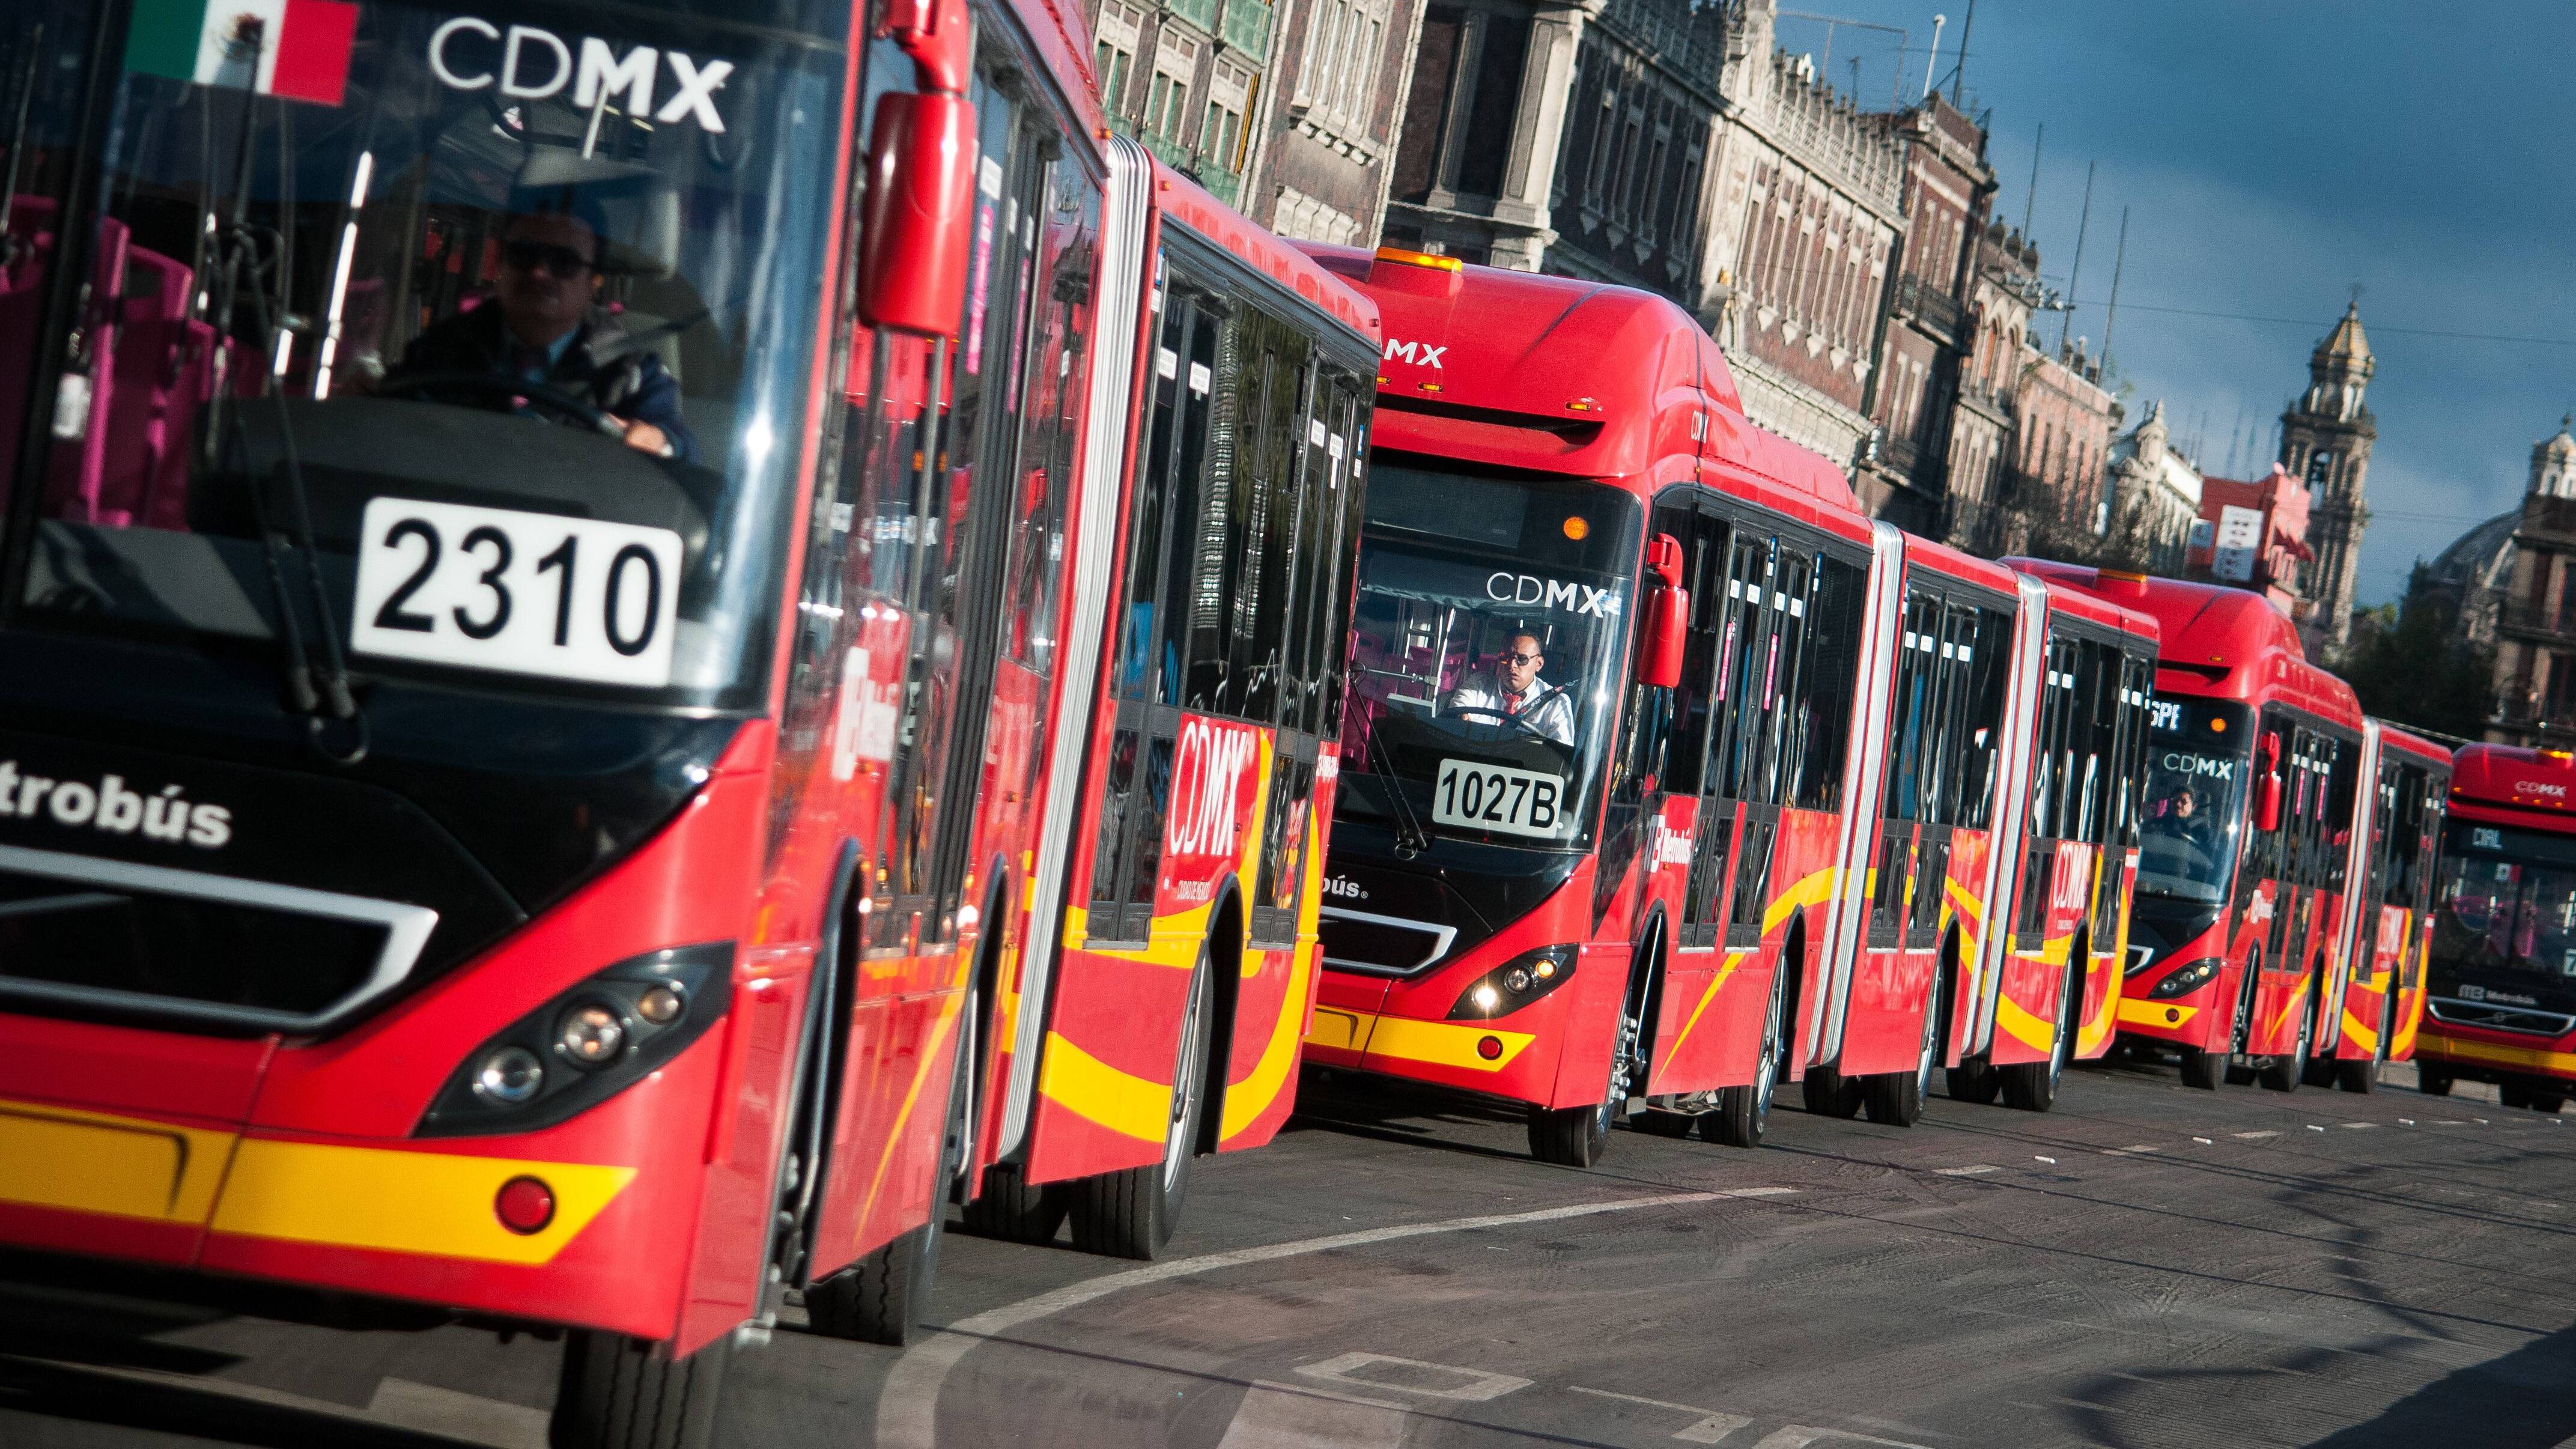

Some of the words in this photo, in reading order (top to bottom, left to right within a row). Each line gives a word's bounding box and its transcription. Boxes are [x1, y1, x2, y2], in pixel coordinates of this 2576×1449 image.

[428, 16, 734, 133] CDMX
[373, 517, 661, 657] 2310
[1486, 572, 1608, 618] CDMX
[1170, 721, 1248, 856] CDMX
[2164, 753, 2234, 781] CDMX
[2515, 780, 2566, 798] CDMX
[1442, 768, 1557, 828] 1027B
[1660, 827, 1693, 864] Metrobús
[2053, 842, 2093, 909] CDMX
